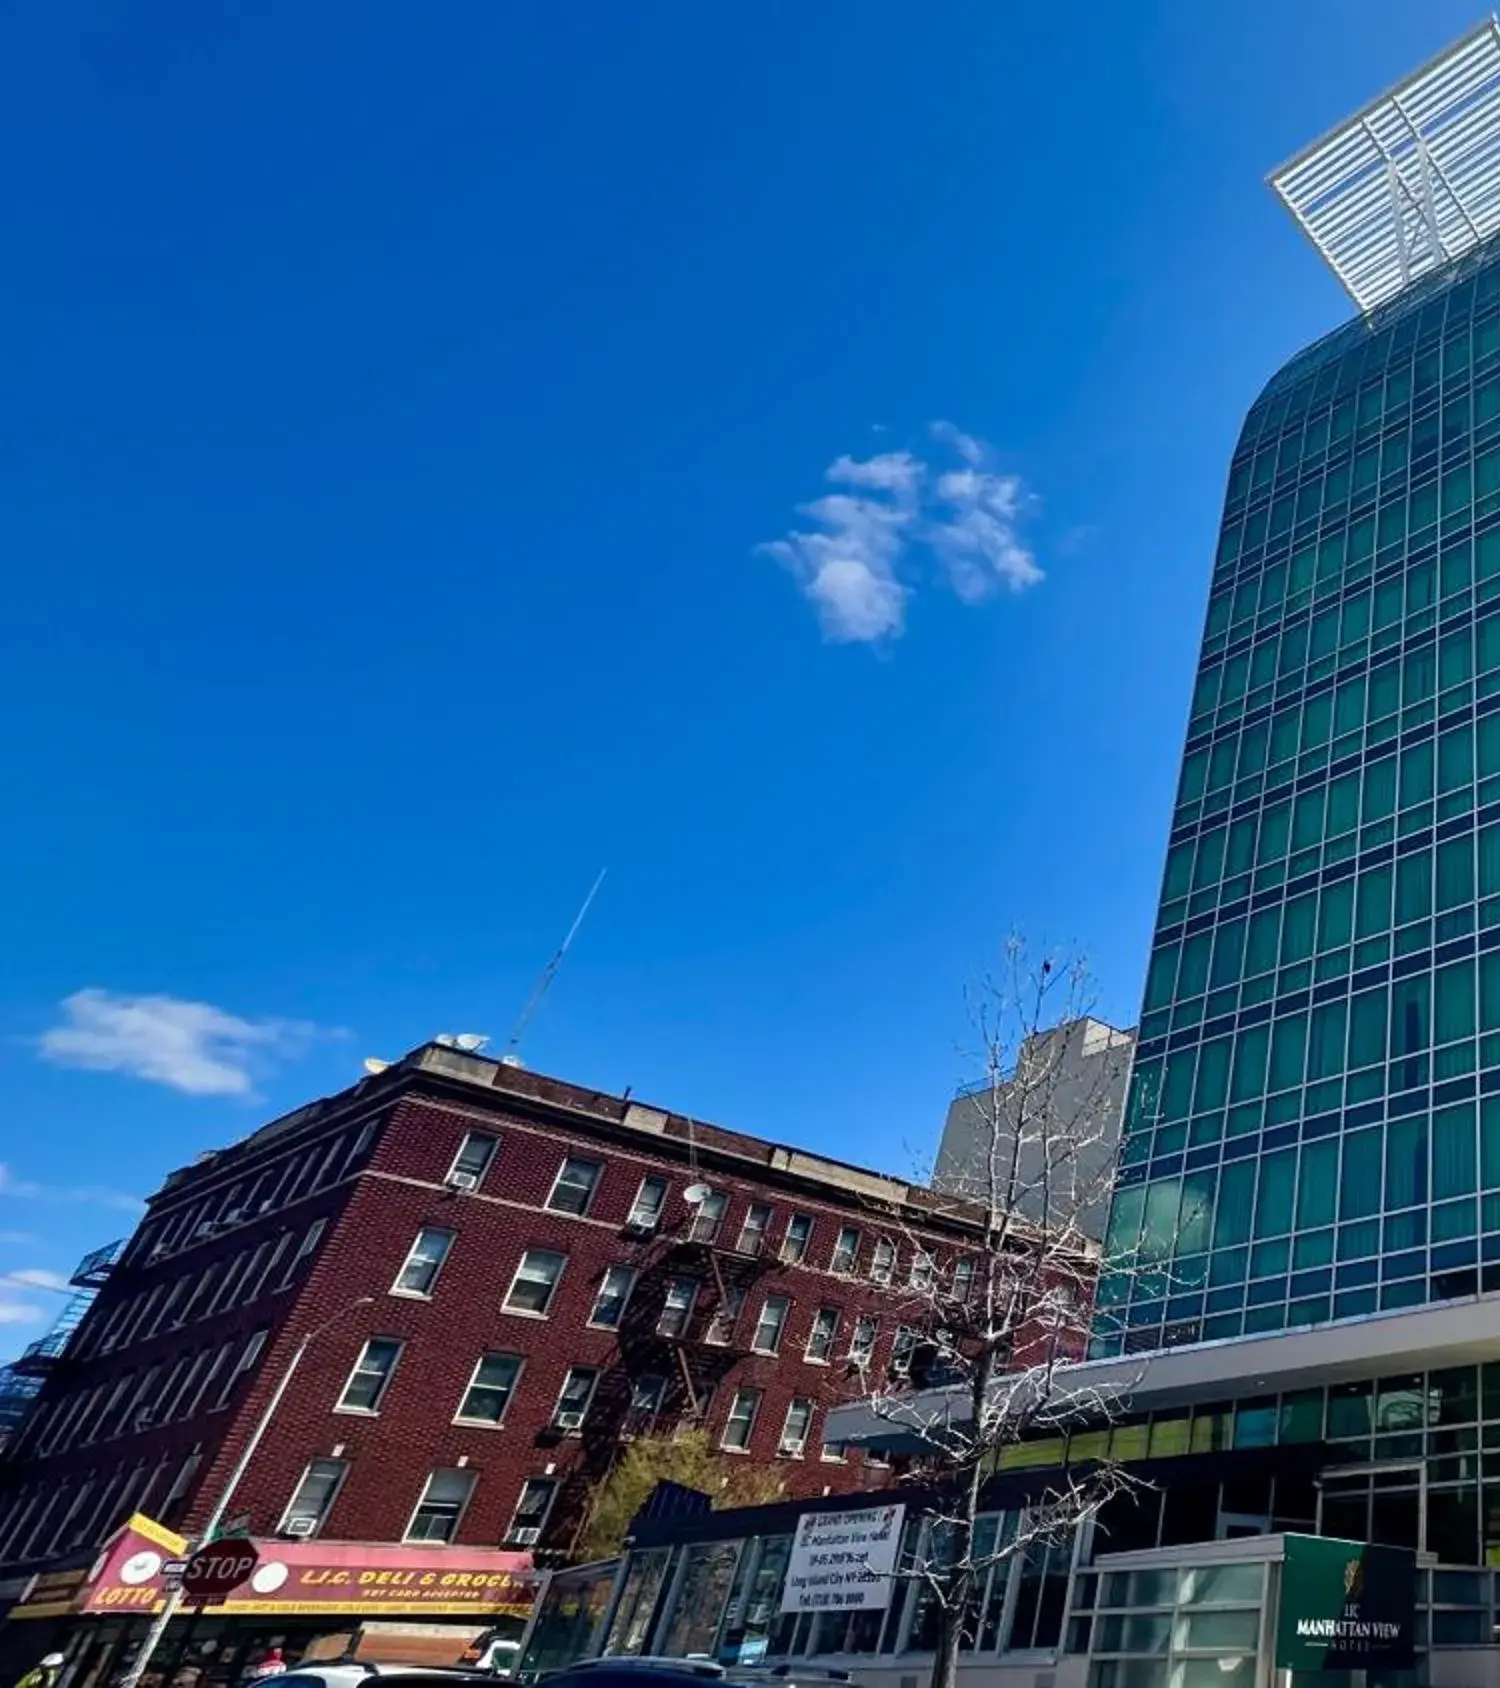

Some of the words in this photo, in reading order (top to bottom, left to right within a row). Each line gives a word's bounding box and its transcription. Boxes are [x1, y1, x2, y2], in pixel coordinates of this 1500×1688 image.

[187, 1556, 253, 1580] STOP
[359, 1571, 416, 1585] DELI
[94, 1587, 158, 1605] LOTTO
[1344, 1603, 1361, 1618] LIC
[1296, 1618, 1371, 1638] MANHATTAN
[1372, 1622, 1400, 1640] VIEW
